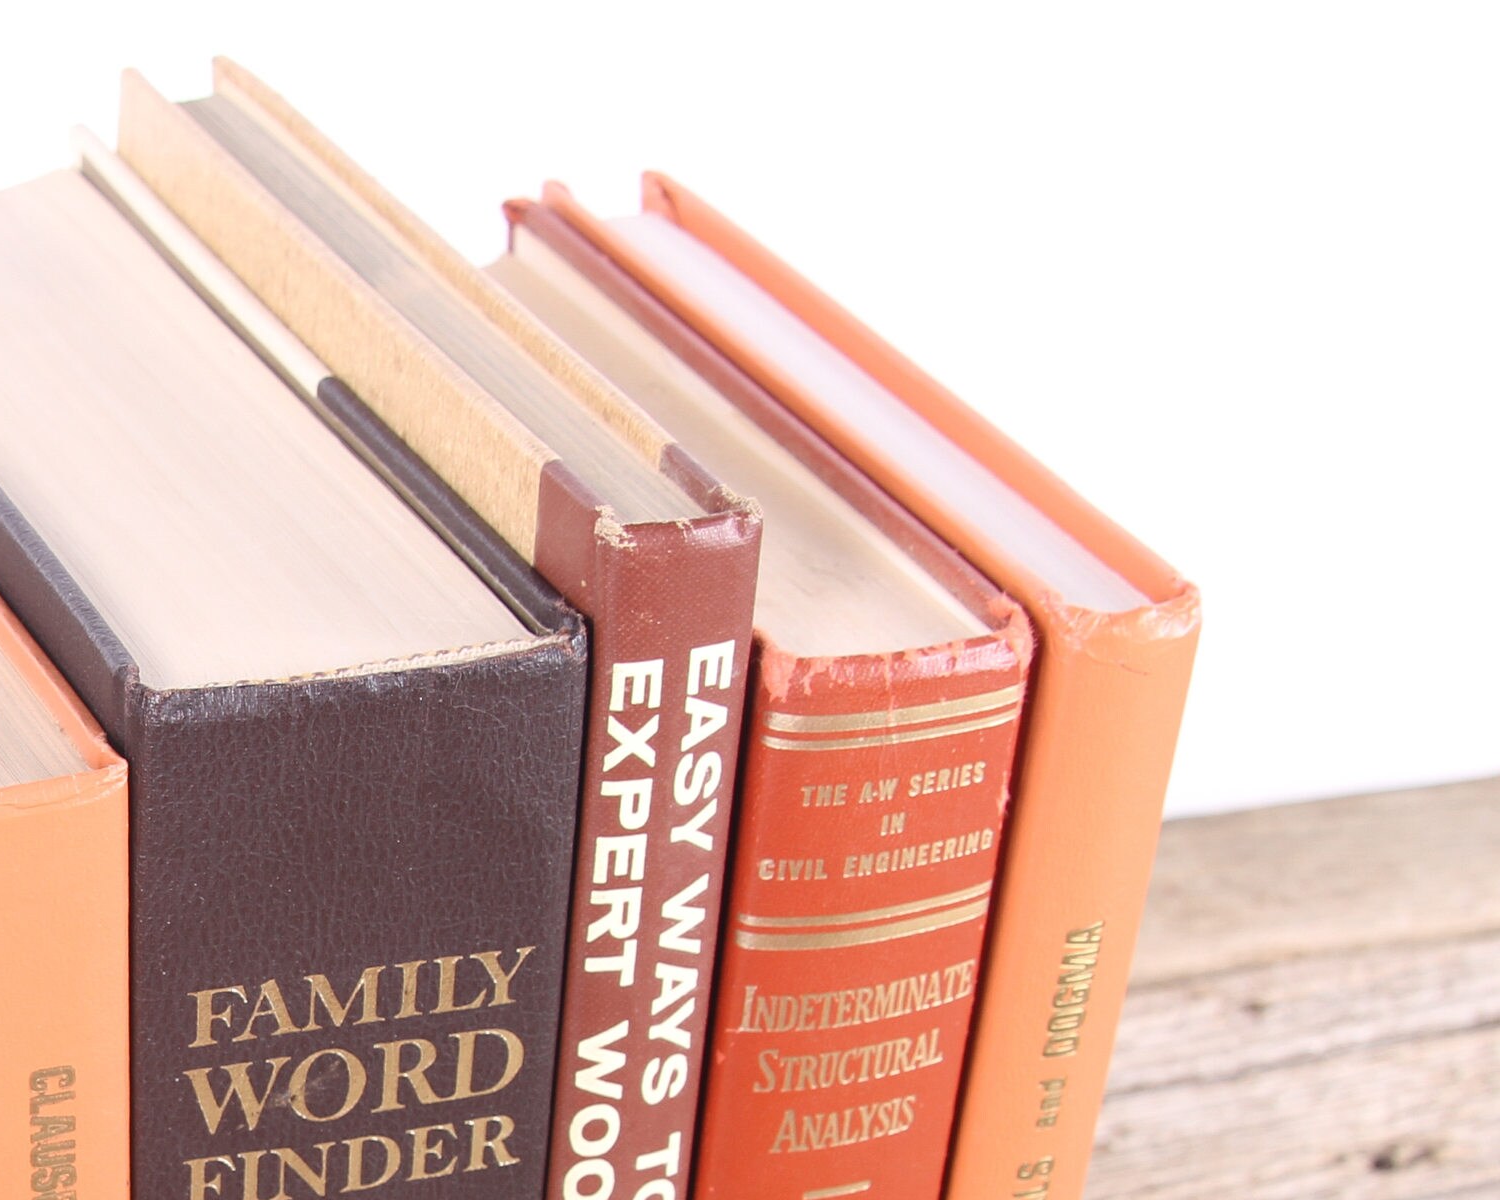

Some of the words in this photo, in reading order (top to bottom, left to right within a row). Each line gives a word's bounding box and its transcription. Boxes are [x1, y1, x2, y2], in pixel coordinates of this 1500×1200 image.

[669, 639, 737, 851] EASY
[801, 781, 848, 807] THE
[908, 761, 986, 798] SERIES
[584, 658, 665, 988] EXPERT
[758, 856, 827, 881] CIVIL
[843, 828, 994, 878] ENGINEERING
[881, 812, 905, 836] IN
[187, 945, 536, 1048] FAMILY
[640, 872, 710, 1106] WAYS
[739, 958, 976, 1034] INDETERMINATE
[1043, 920, 1106, 1058] DOGMA
[182, 1027, 525, 1136] WORD
[753, 1028, 943, 1094] STRUCTURAL
[769, 1095, 917, 1154] ANALYSIS
[1036, 1077, 1066, 1129] and
